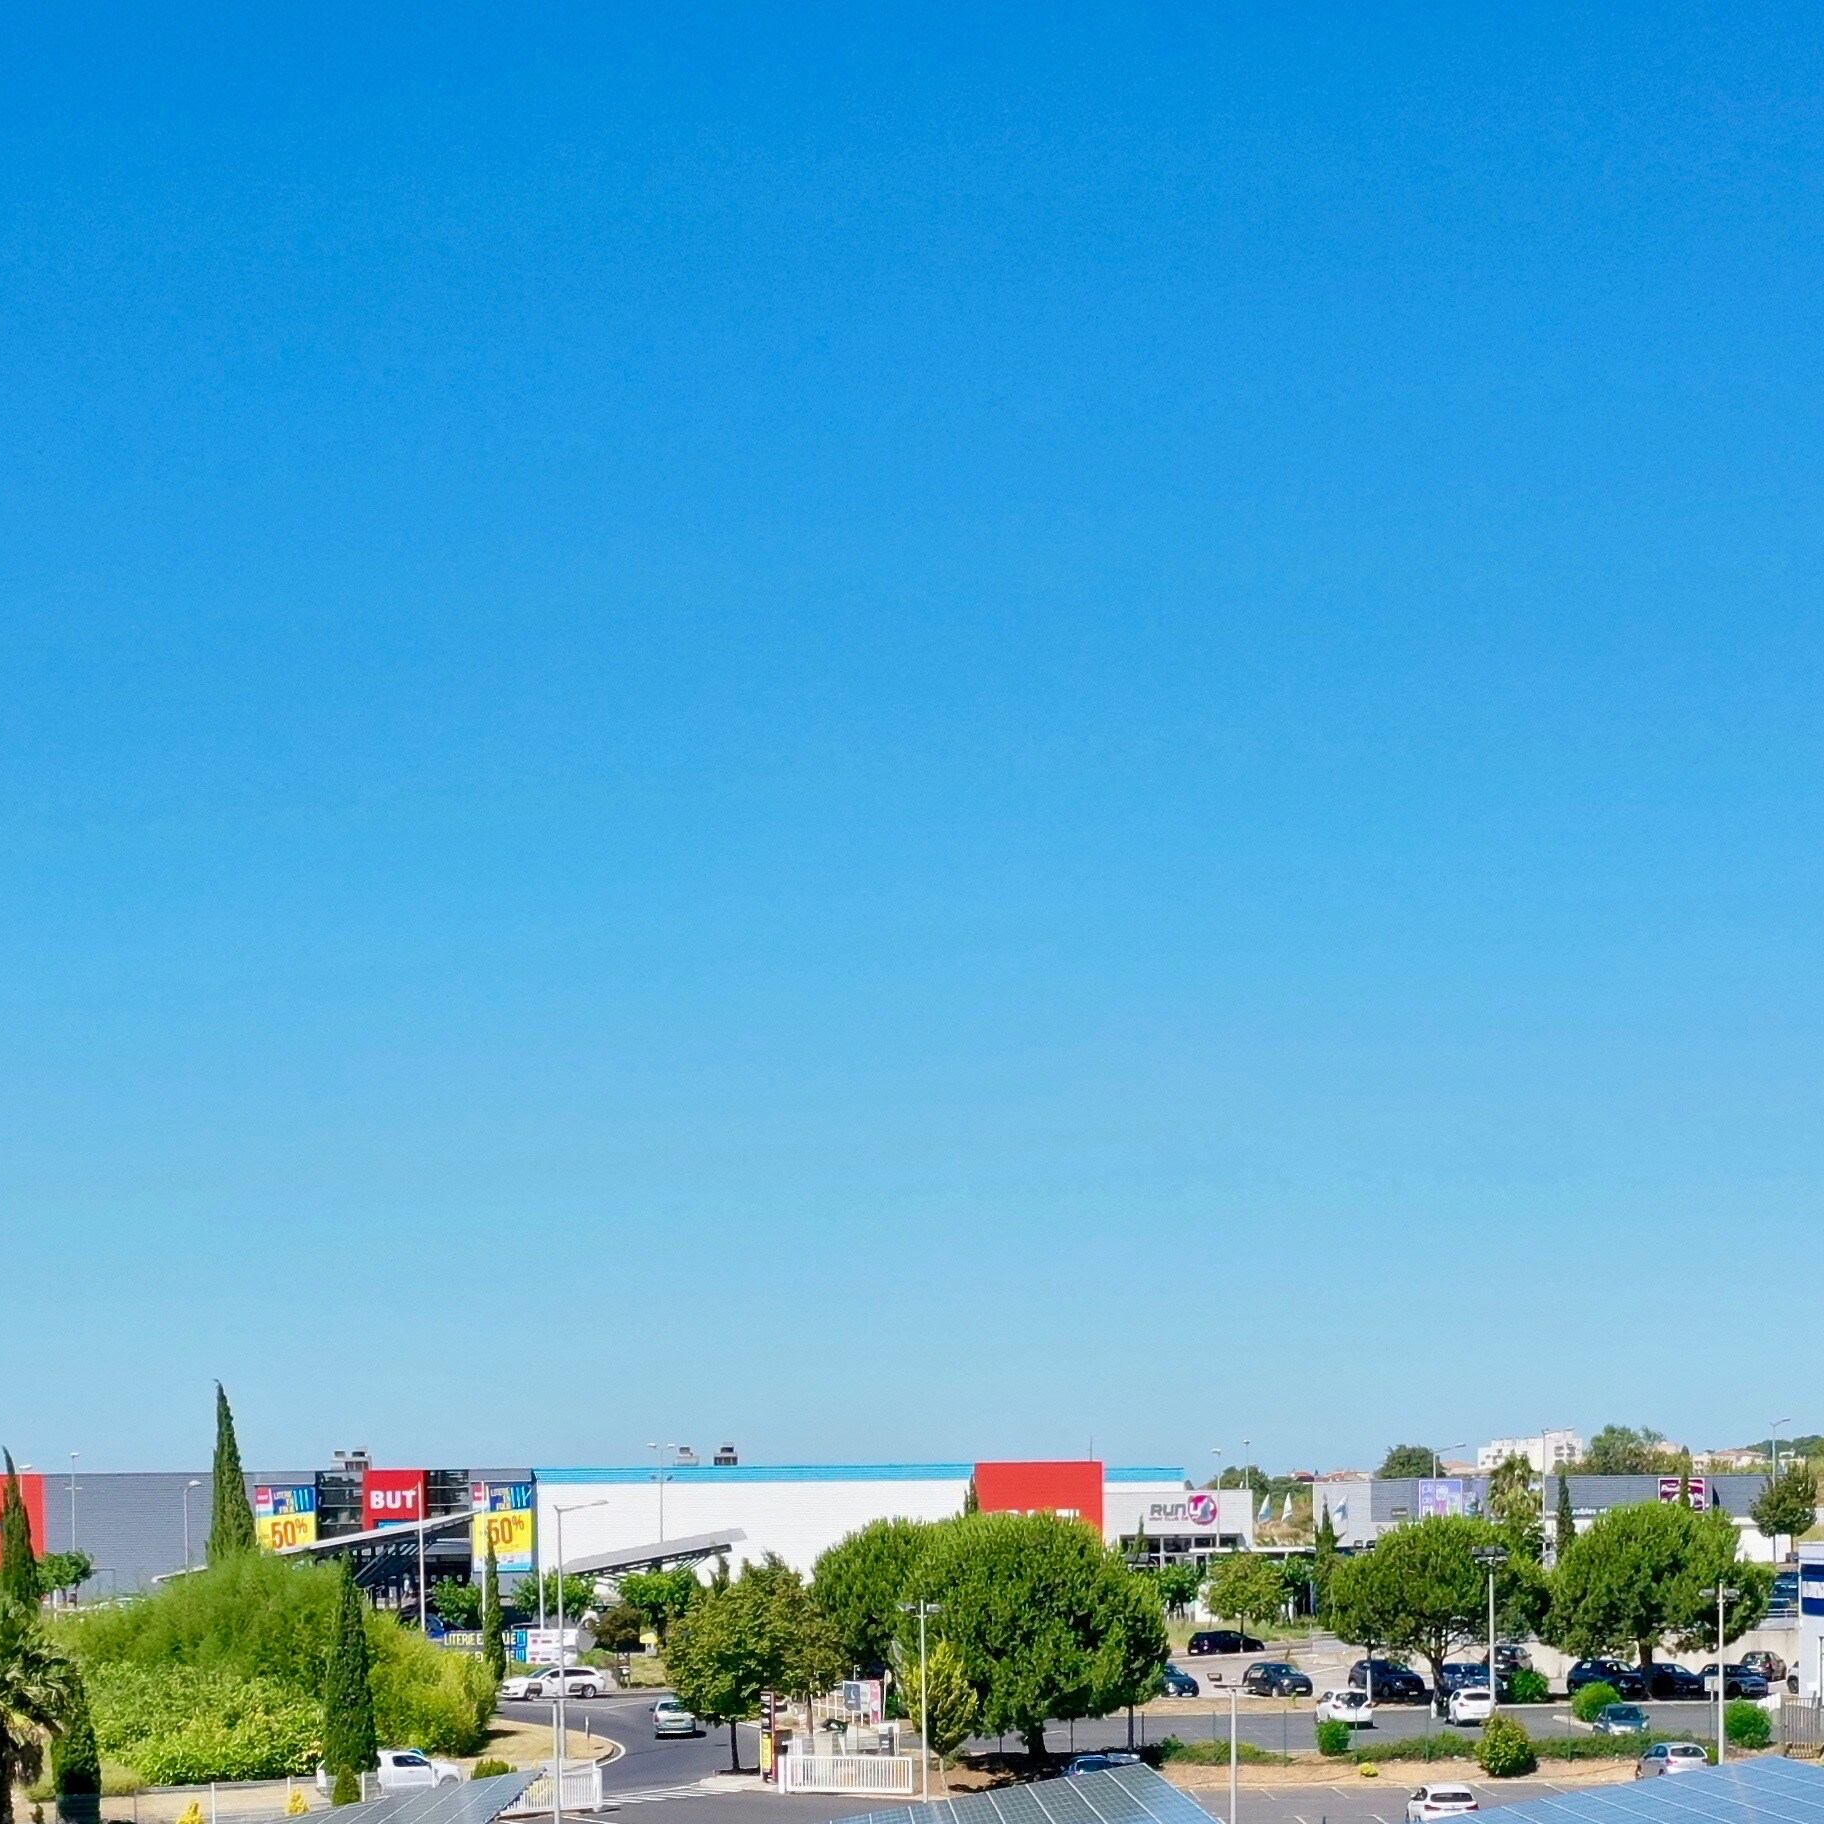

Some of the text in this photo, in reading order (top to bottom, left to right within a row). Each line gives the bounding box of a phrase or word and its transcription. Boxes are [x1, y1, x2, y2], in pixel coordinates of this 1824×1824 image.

[370, 1490, 417, 1510] BUT
[271, 1517, 308, 1549] 50%
[487, 1514, 525, 1546] 50%
